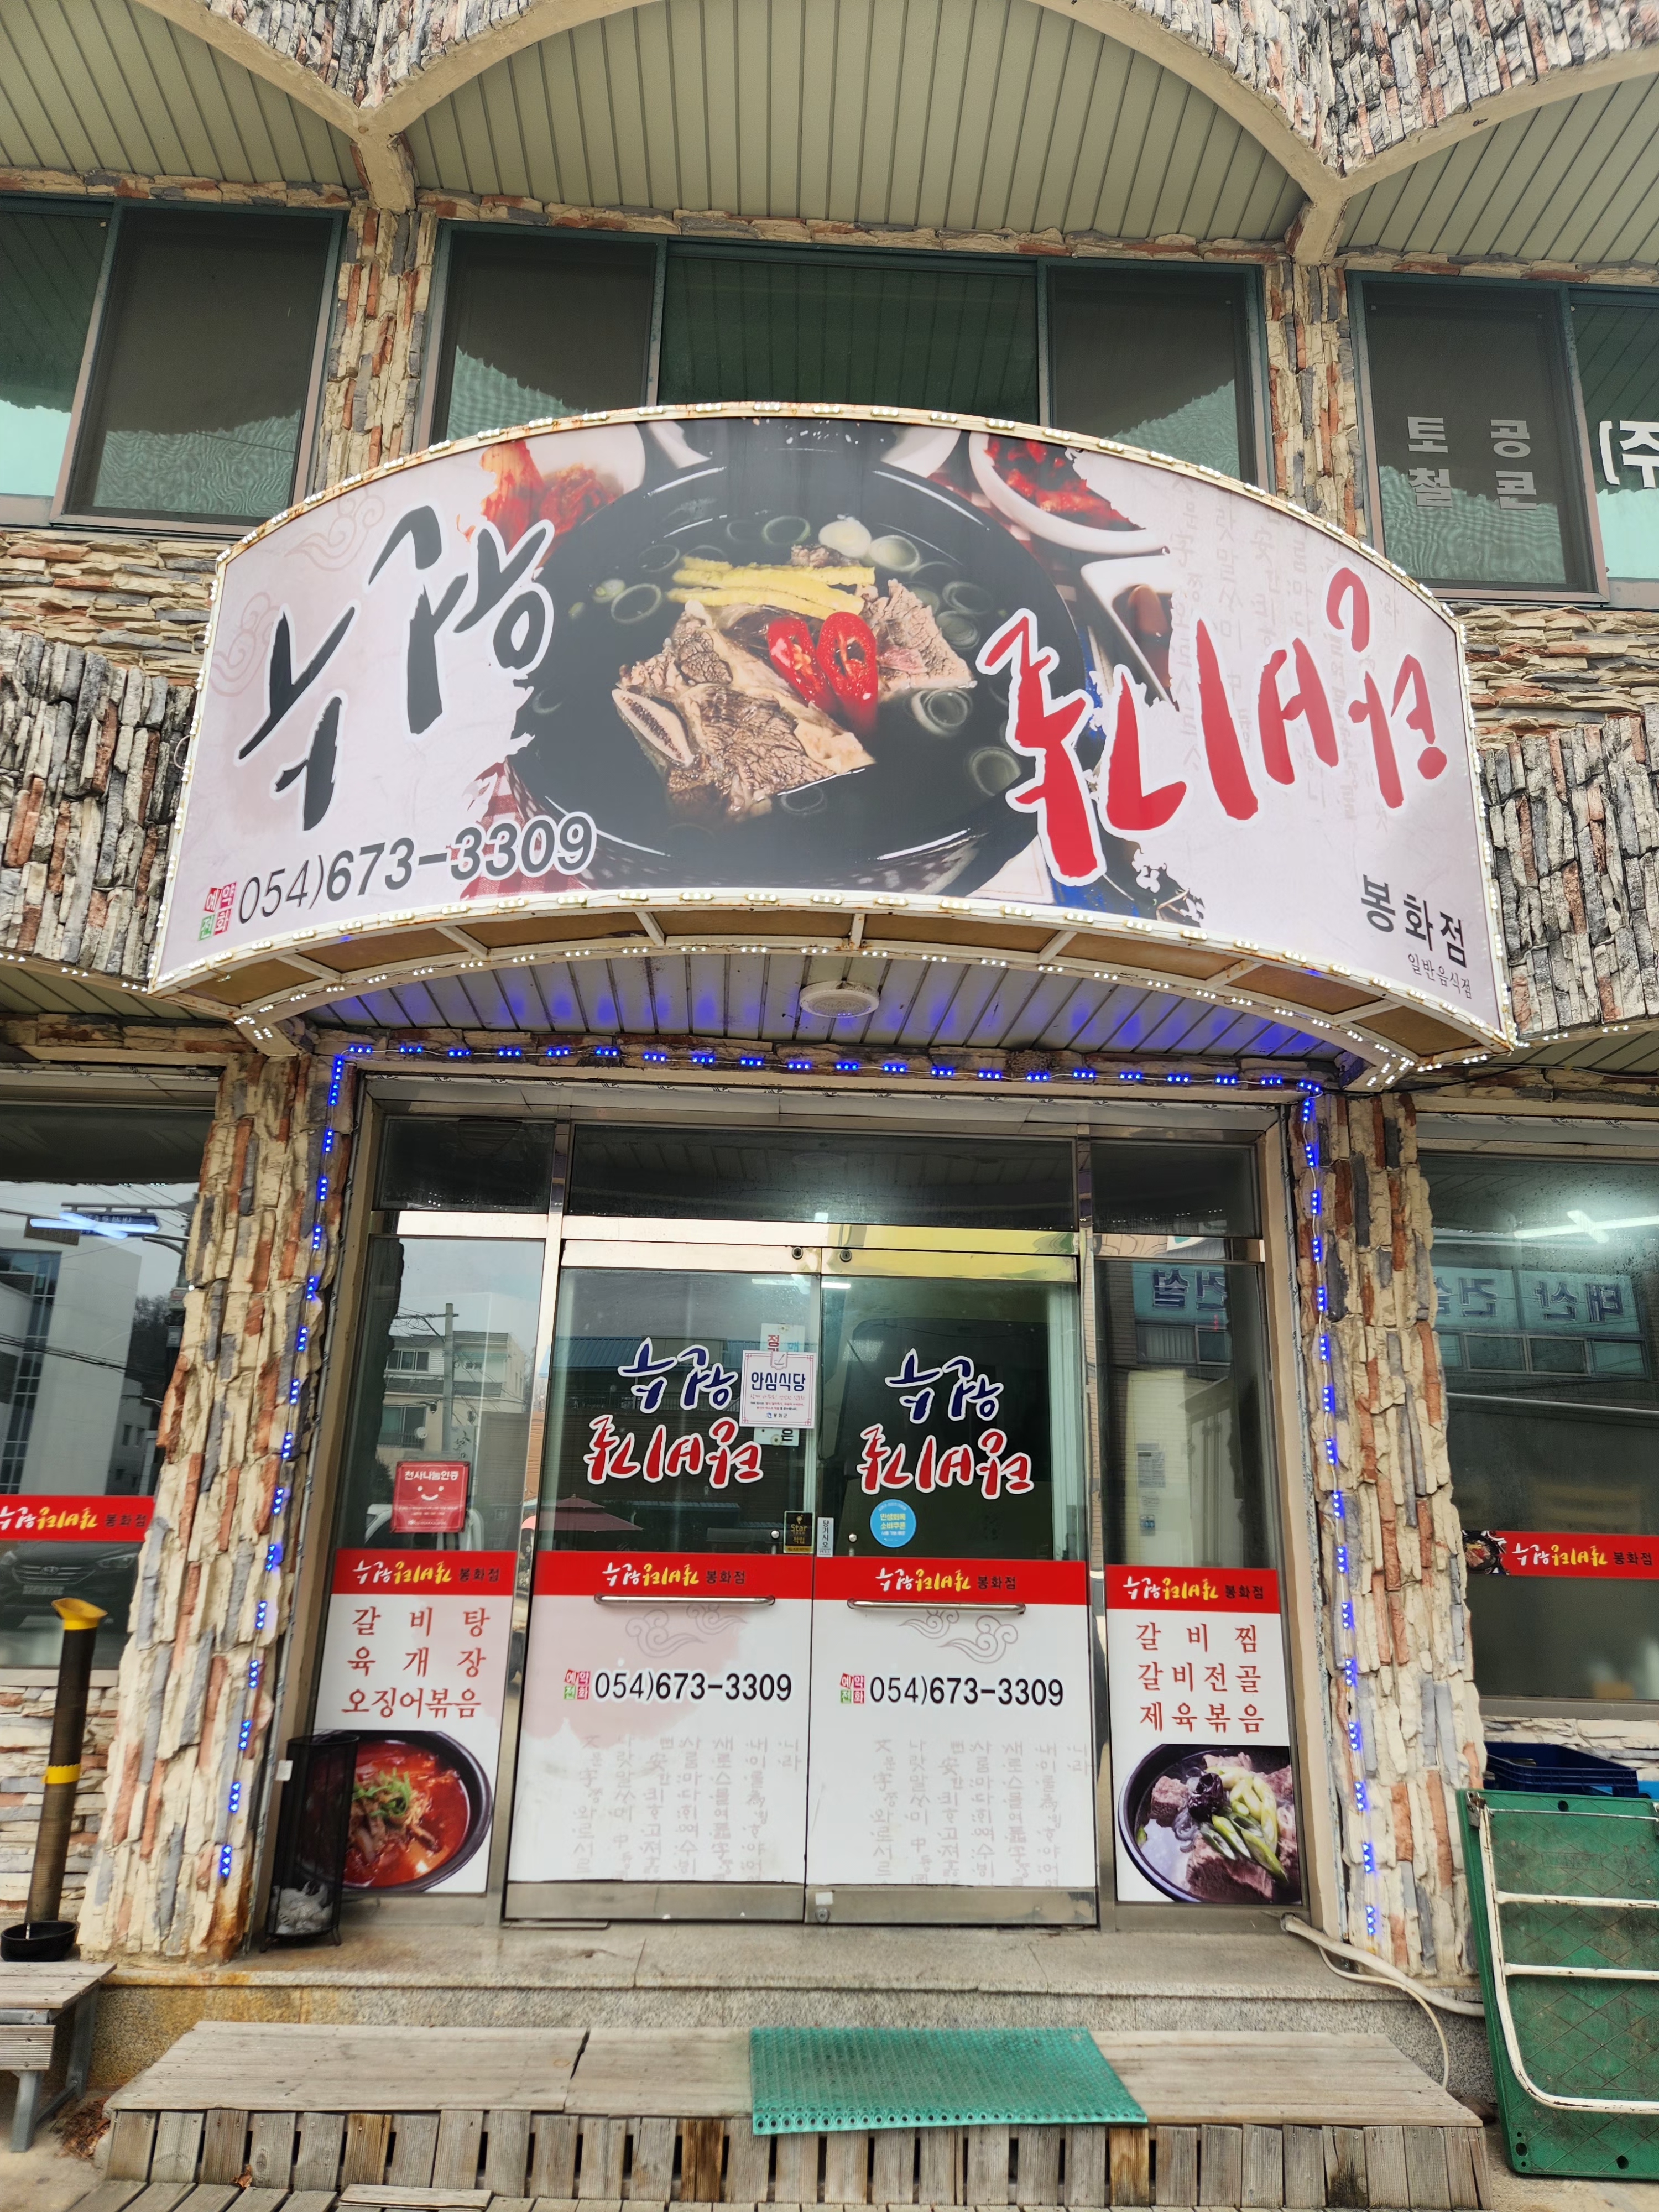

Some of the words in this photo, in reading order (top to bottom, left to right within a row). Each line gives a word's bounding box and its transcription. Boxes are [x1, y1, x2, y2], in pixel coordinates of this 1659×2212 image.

[239, 815, 593, 924] 054)673-3309
[205, 883, 236, 911] 예약
[200, 910, 229, 940] 전화
[1361, 874, 1467, 968] 봉화점
[1408, 953, 1472, 999] 일반음식점
[751, 1371, 806, 1392] 안심식당
[405, 1470, 458, 1480] 천사나눔인증
[106, 1514, 147, 1527] 봉화점
[1613, 1551, 1652, 1566] 봉화점
[458, 1567, 500, 1582] 봉화점
[706, 1570, 745, 1585] 봉화점
[977, 1575, 1016, 1590] 봉화점
[1224, 1584, 1264, 1599] 봉화점
[565, 1671, 589, 1684] 예약
[841, 1674, 864, 1688] 예약
[1138, 1661, 1261, 1693] 갈비전골
[564, 1686, 589, 1699] 전화
[595, 1672, 792, 1702] 054)673-3309
[870, 1676, 1063, 1706] 054)673-3309
[341, 1687, 481, 1719] 오징어볶음
[841, 1690, 864, 1703] 전화
[1140, 1702, 1264, 1734] 제육볶음
